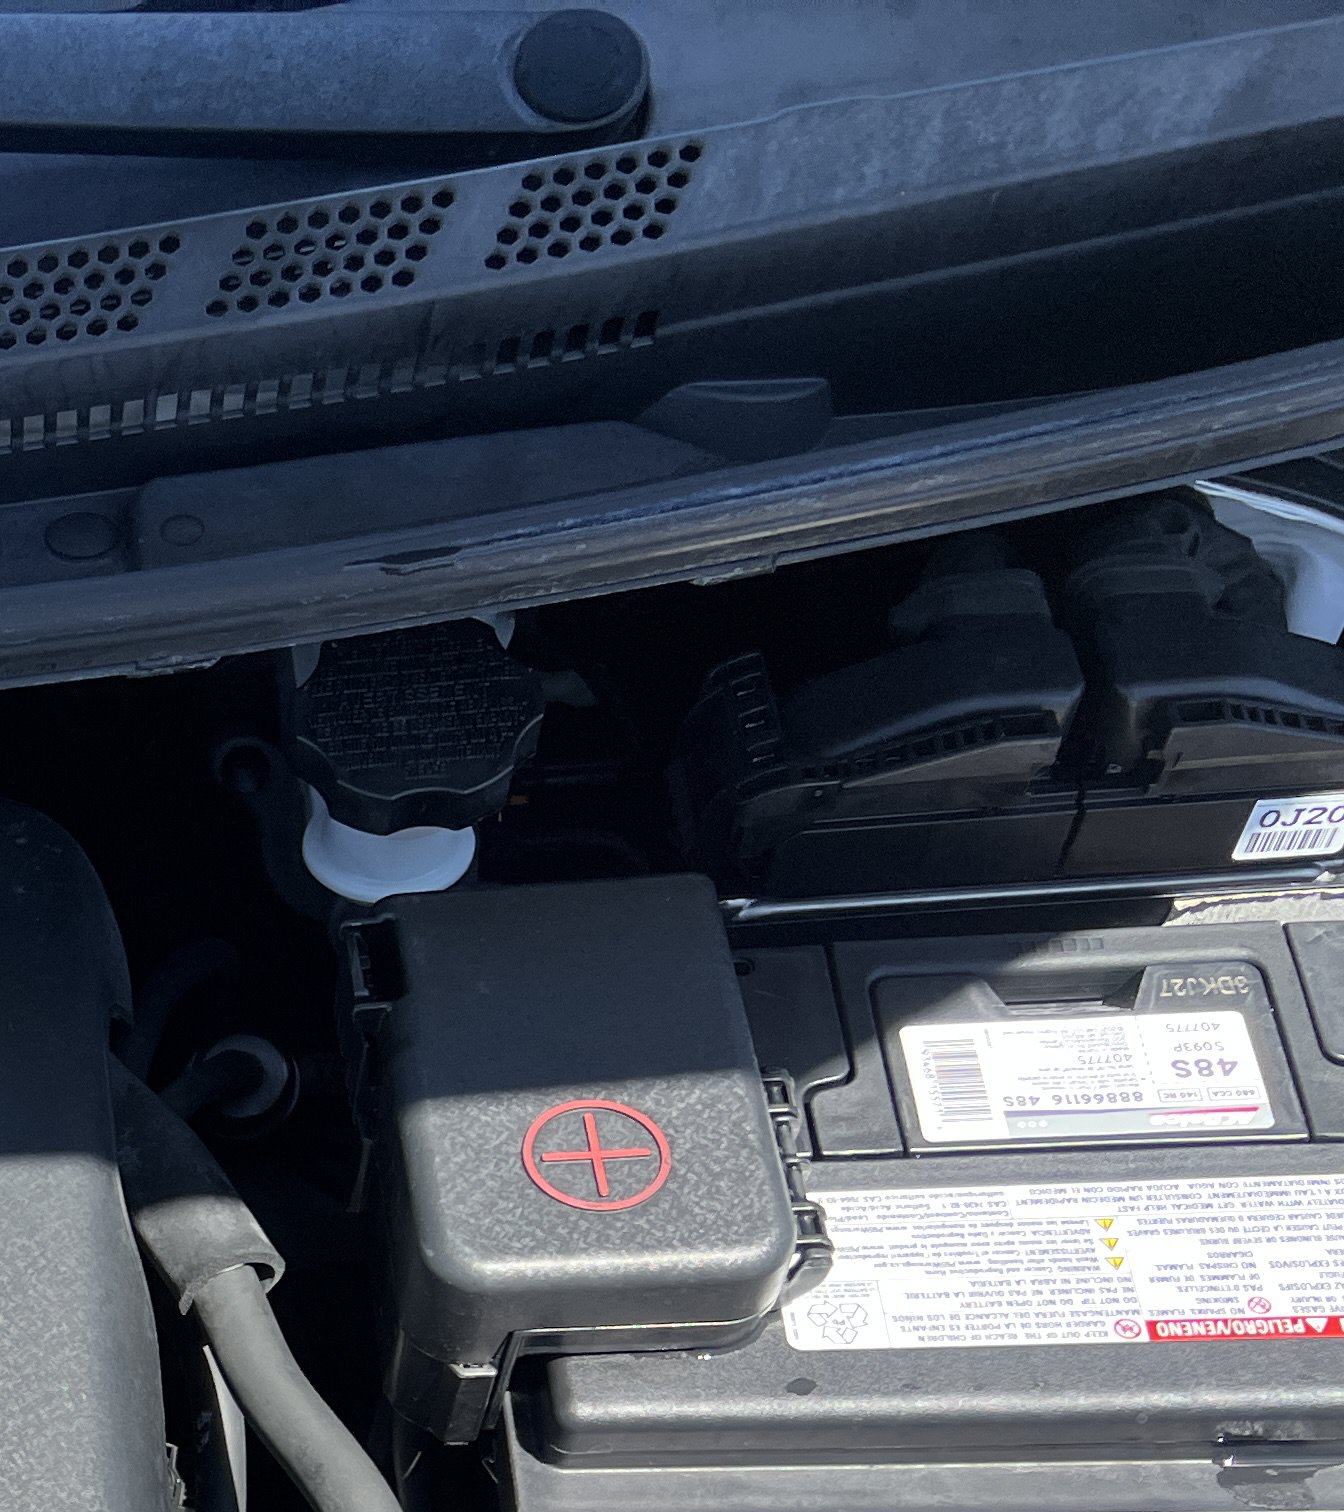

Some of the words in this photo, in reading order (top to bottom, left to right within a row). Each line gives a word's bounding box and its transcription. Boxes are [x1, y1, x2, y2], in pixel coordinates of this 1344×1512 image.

[1166, 1022, 1220, 1033] 407775
[1078, 1053, 1132, 1065] 407775
[1171, 1058, 1239, 1079] 48S
[1003, 1095, 1040, 1107] 48S
[1052, 1091, 1143, 1106] 88866116
[1155, 1318, 1305, 1337] PELIGRO/VENENO
